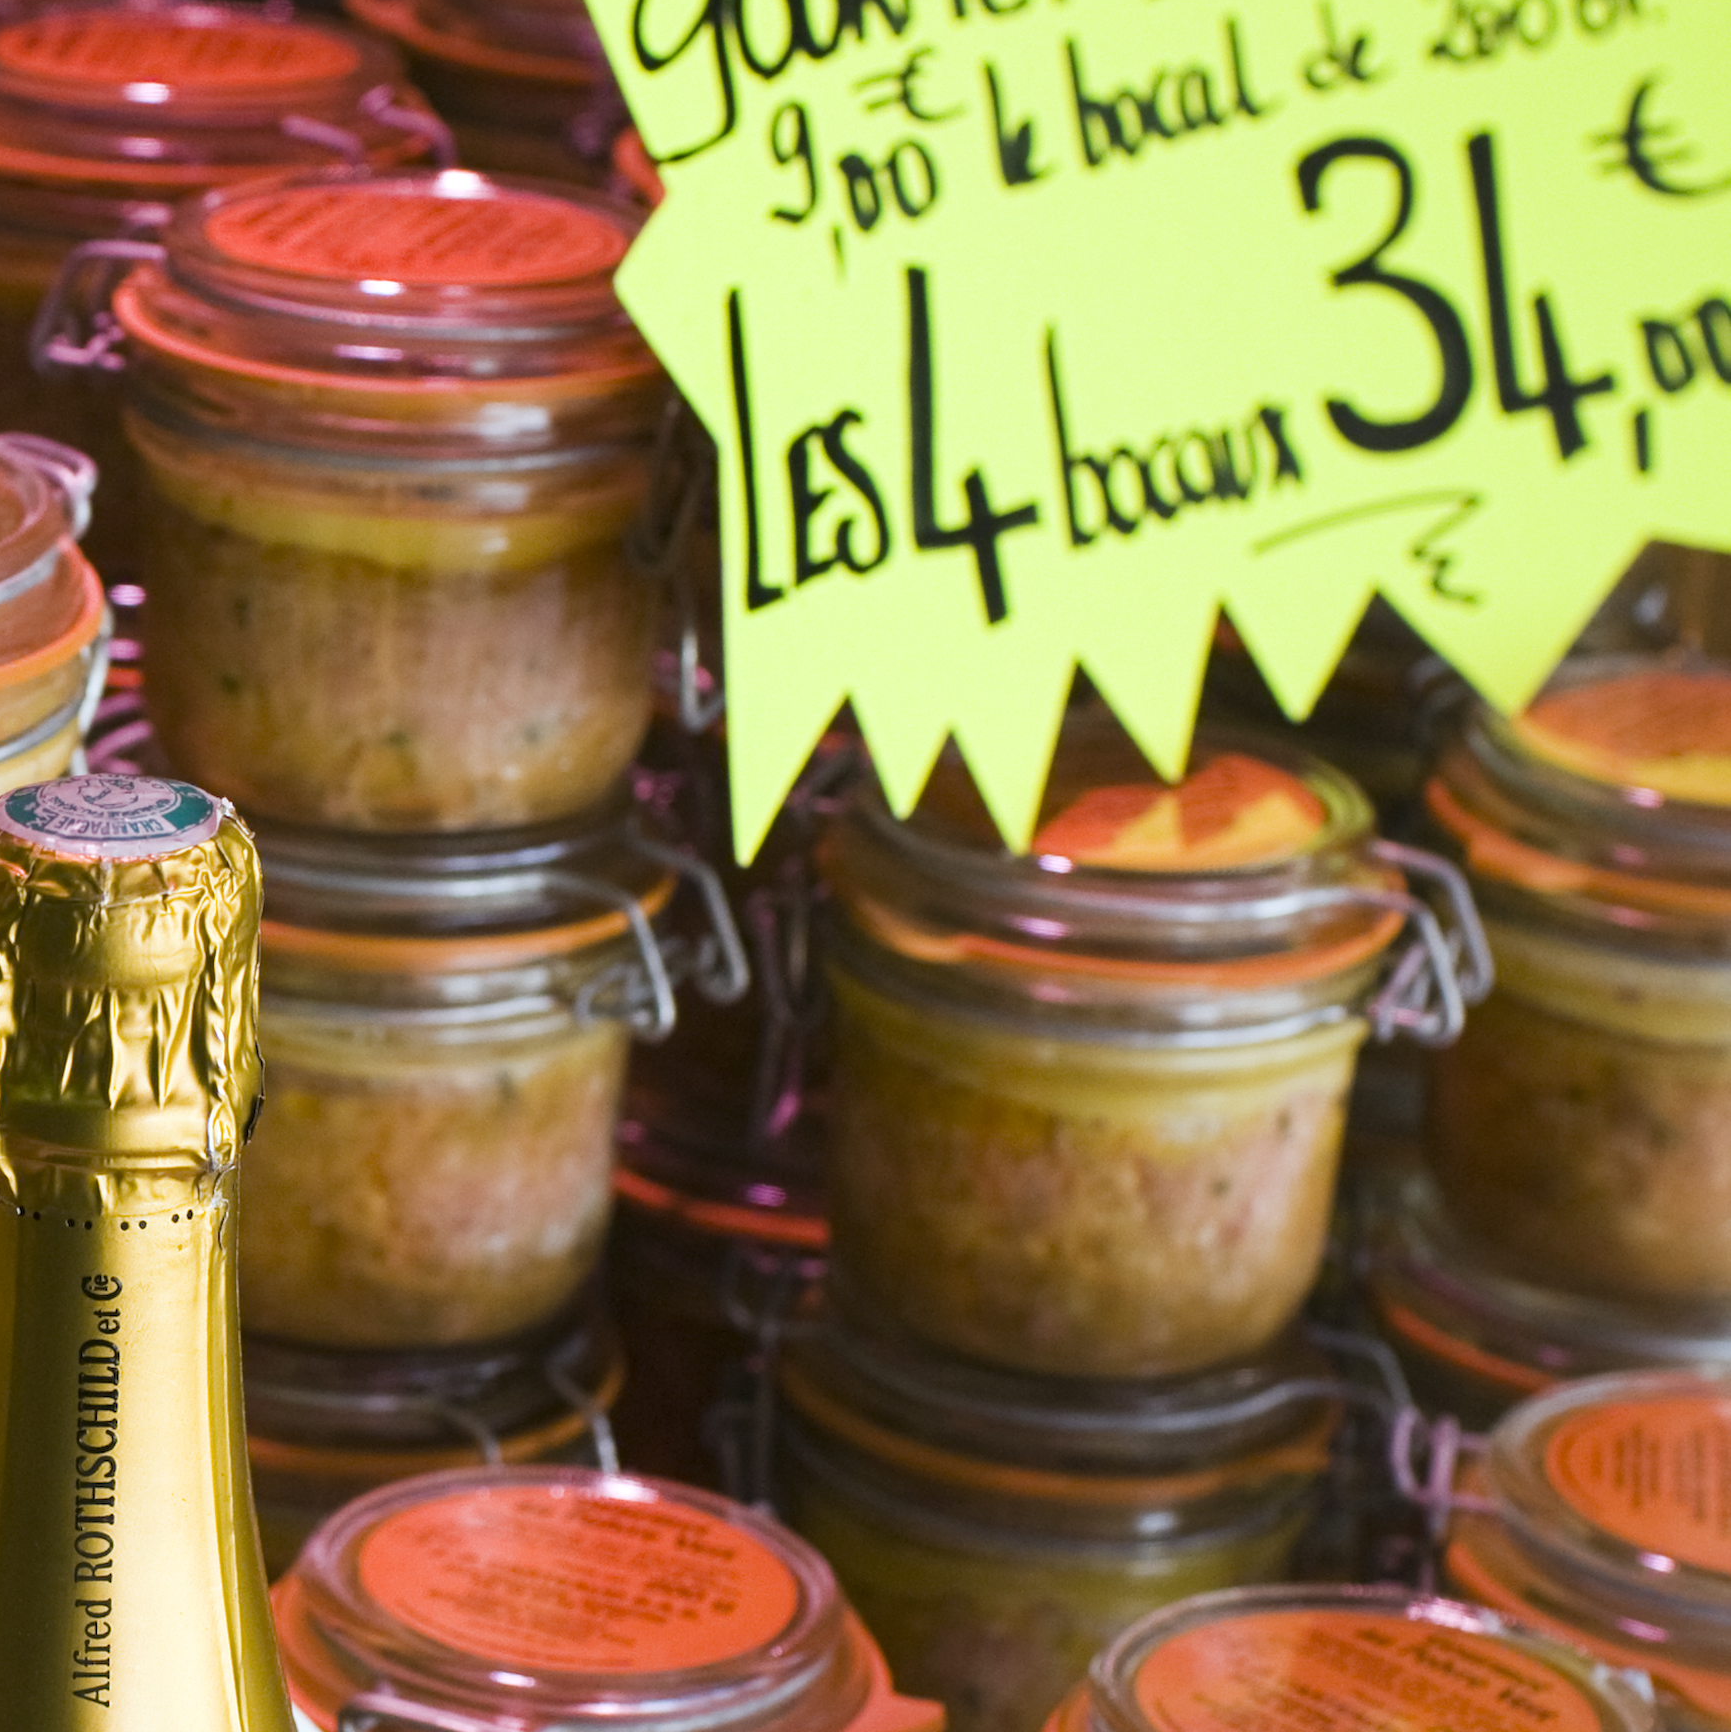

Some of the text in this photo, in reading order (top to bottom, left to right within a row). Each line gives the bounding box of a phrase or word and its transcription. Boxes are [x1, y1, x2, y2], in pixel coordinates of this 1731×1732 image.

[1066, 21, 1275, 171] bocal
[1303, 0, 1383, 97] de
[908, 267, 1039, 624] 4
[1045, 326, 1303, 548] bocaux
[99, 1310, 120, 1334] et
[75, 1338, 121, 1585] ROTHSCHILD
[72, 1597, 113, 1709] Alfred
